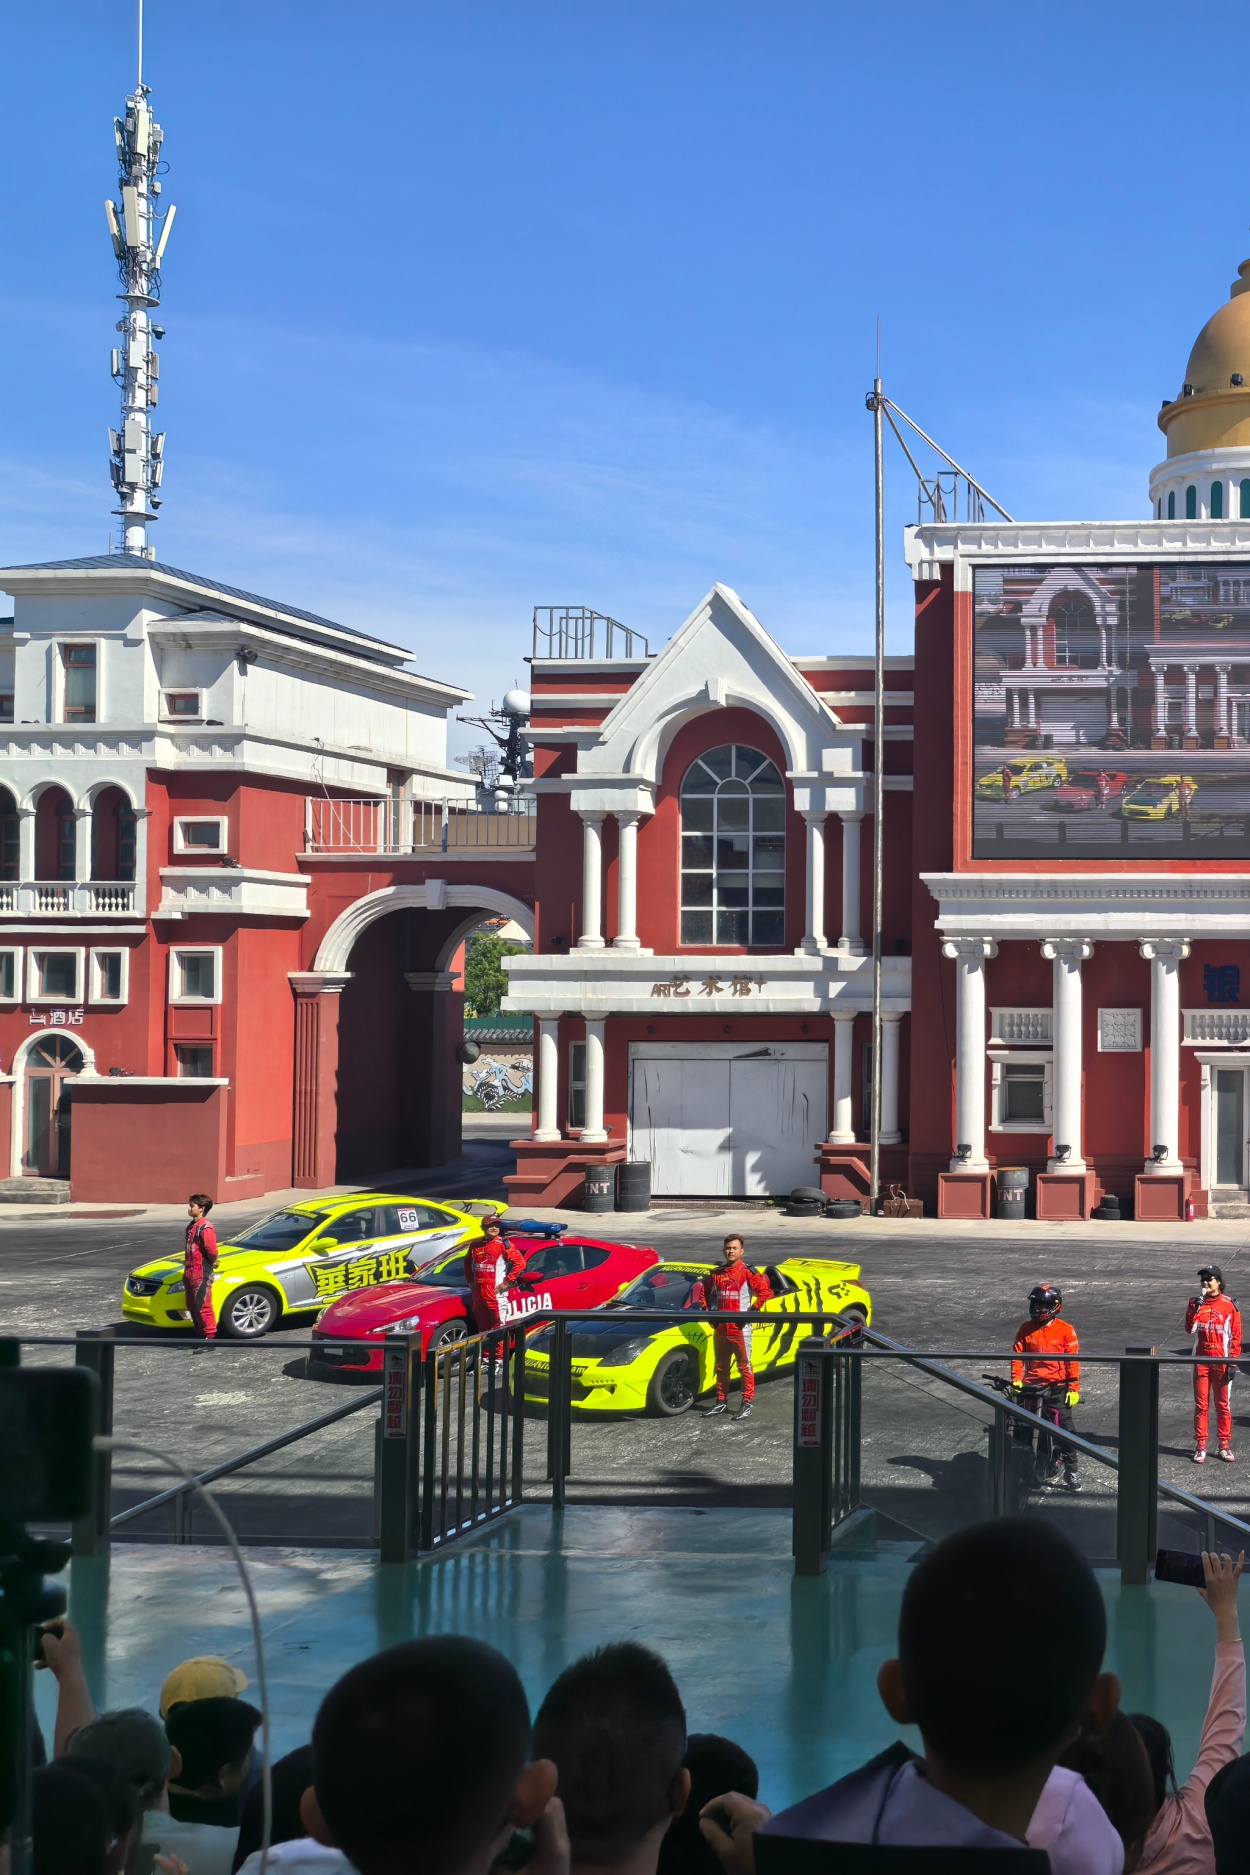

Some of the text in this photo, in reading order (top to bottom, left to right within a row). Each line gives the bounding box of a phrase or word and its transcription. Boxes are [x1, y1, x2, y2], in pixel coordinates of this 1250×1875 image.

[669, 974, 754, 998] 艺术馆
[50, 1009, 84, 1025] 酒店
[400, 1211, 417, 1223] 66
